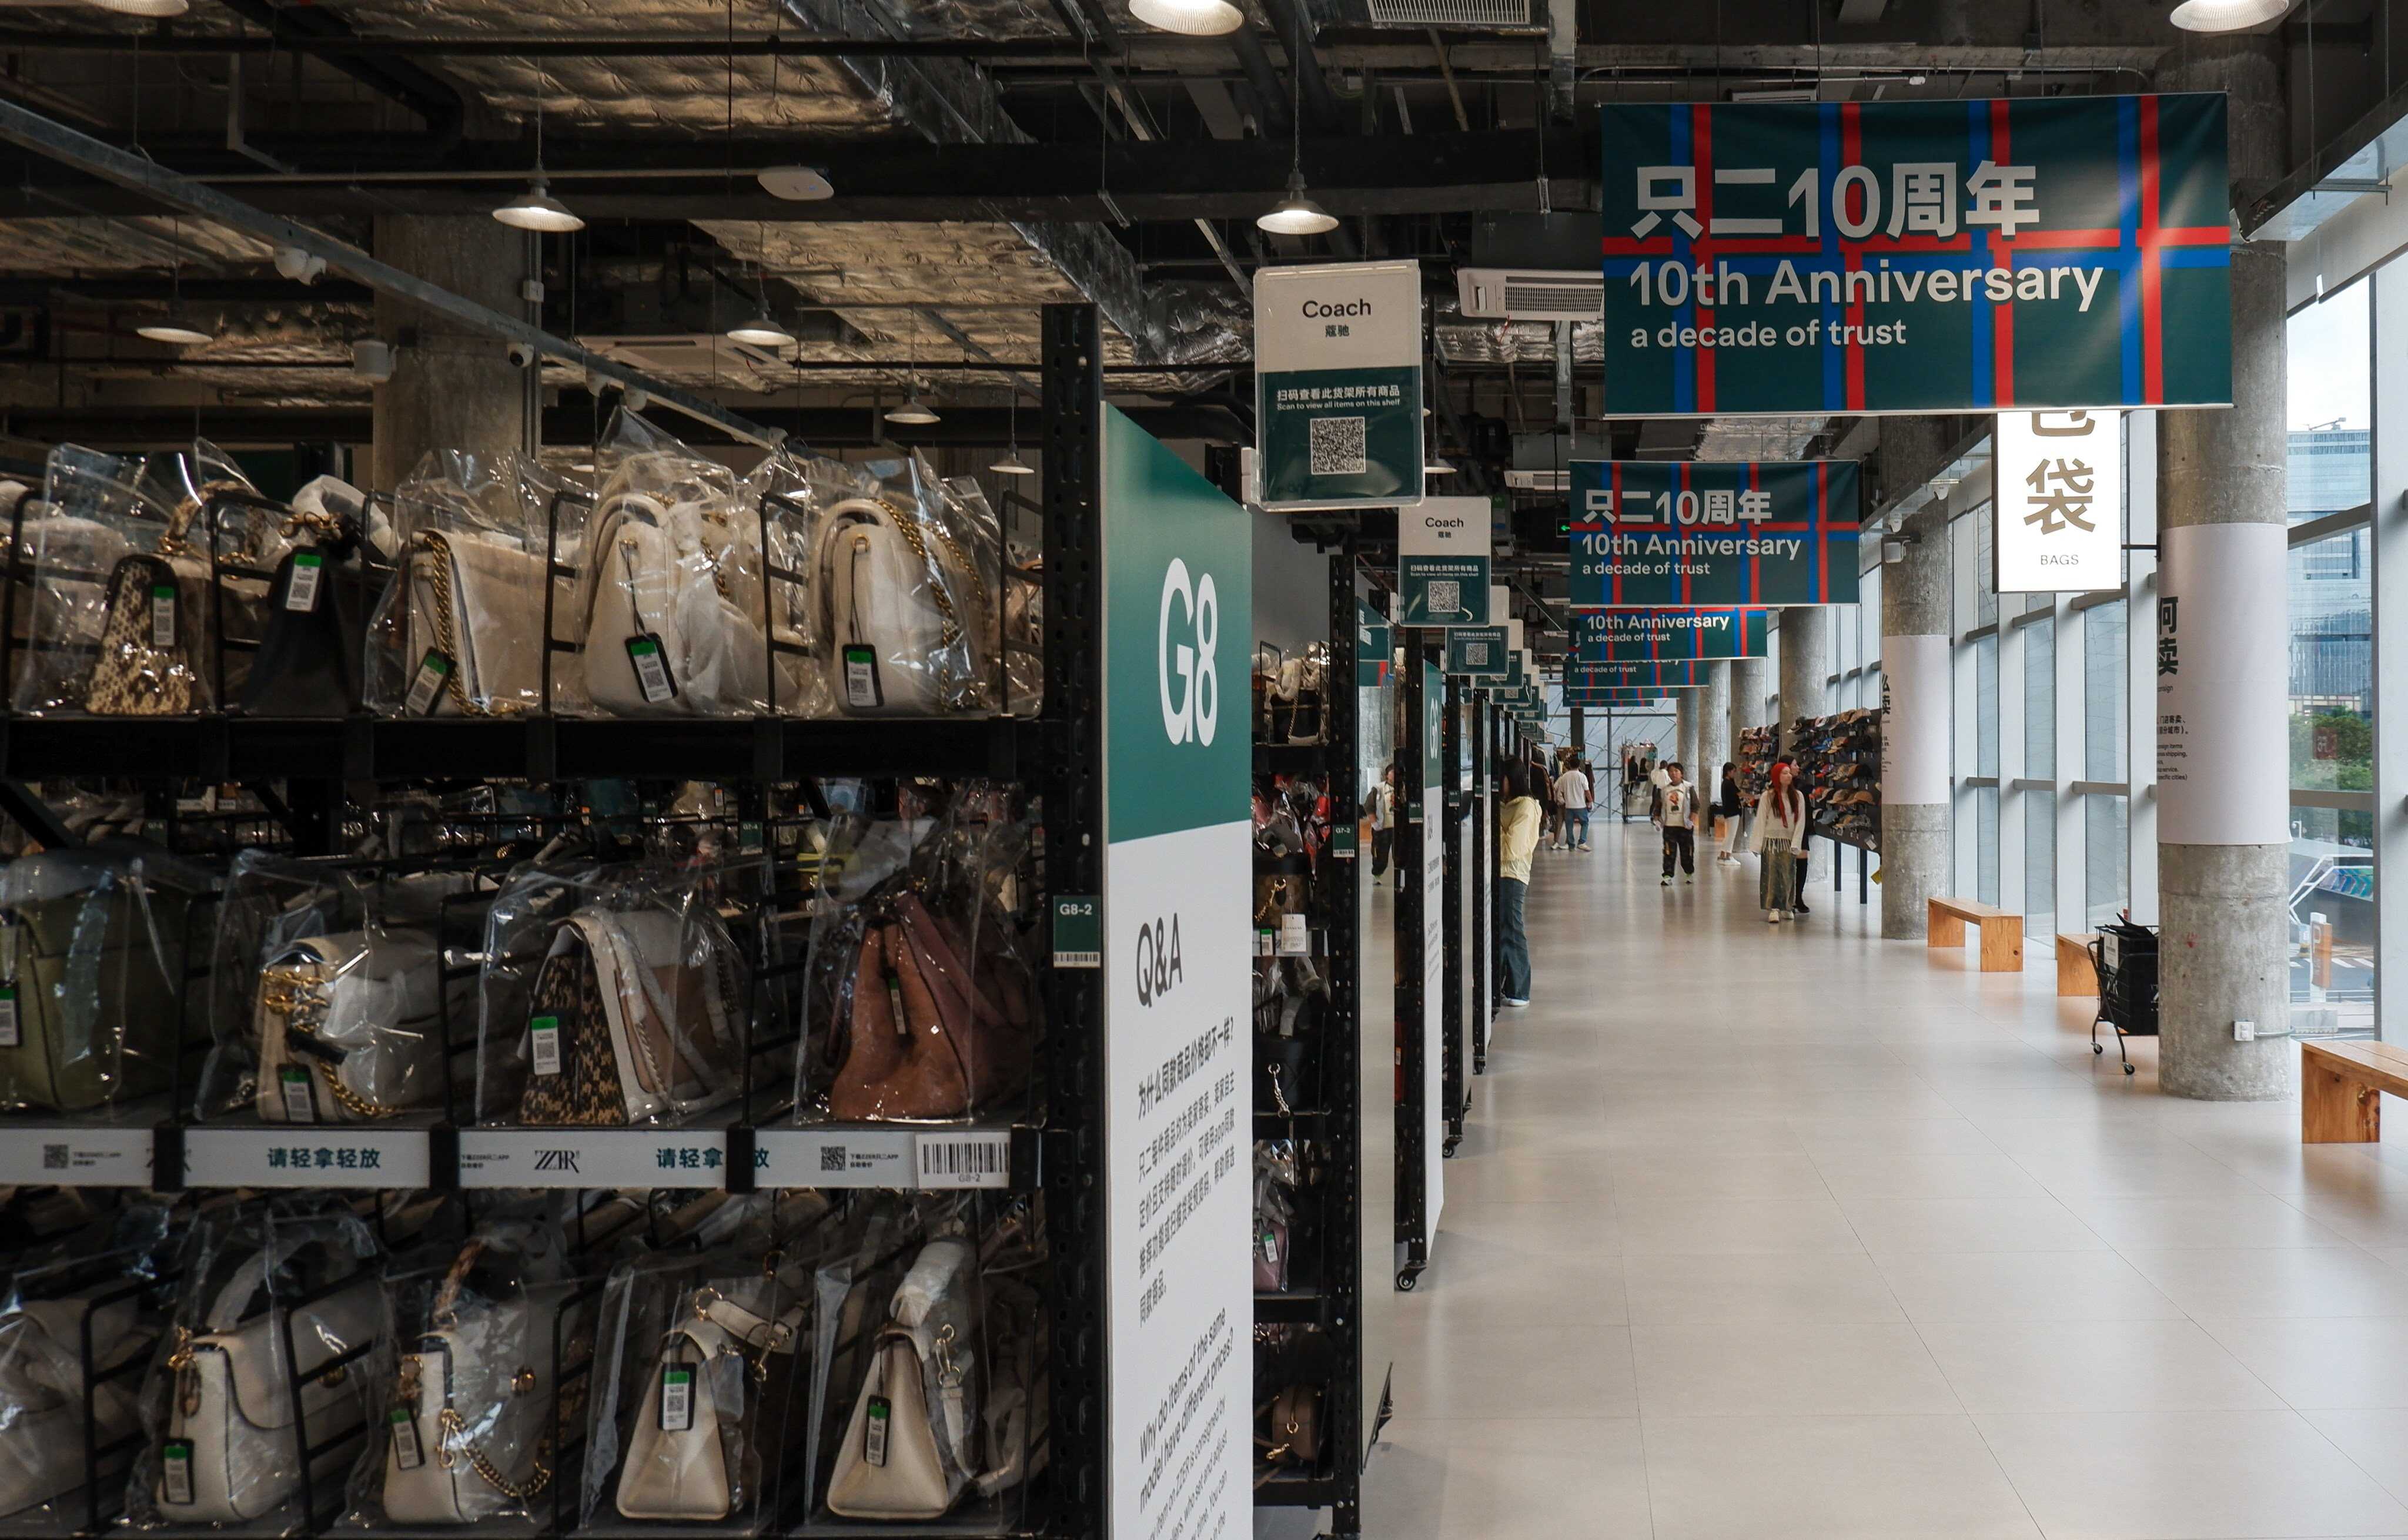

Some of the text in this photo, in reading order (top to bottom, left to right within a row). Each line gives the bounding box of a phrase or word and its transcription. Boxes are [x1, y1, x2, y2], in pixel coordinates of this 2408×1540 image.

[1631, 160, 2040, 239] 只二10周年
[1631, 258, 2103, 312] 10th Anniversary
[1302, 299, 1372, 318] Coach
[1631, 318, 1907, 348] a decade of trust
[1277, 403, 1295, 411] Scan
[1583, 490, 1772, 525] 只二10周年
[1426, 517, 1464, 528] Coach
[1582, 534, 1801, 560] 10th Anniversary
[1583, 561, 1710, 575] a decade of trust
[2040, 554, 2079, 565] BAGS
[1587, 614, 1730, 631] 10th Anniversary
[1596, 633, 1631, 642] decade
[1634, 633, 1645, 642] of
[1646, 633, 1671, 642] trust
[1159, 557, 1218, 747] G8
[1059, 903, 1093, 916] G8-2
[1136, 913, 1182, 1007] Q&A
[267, 1147, 380, 1169] 请轻拿轻放
[958, 1174, 981, 1183] G8-2
[1141, 1307, 1226, 1464] Why do items of the same
[1141, 1327, 1233, 1514] model have different prices?
